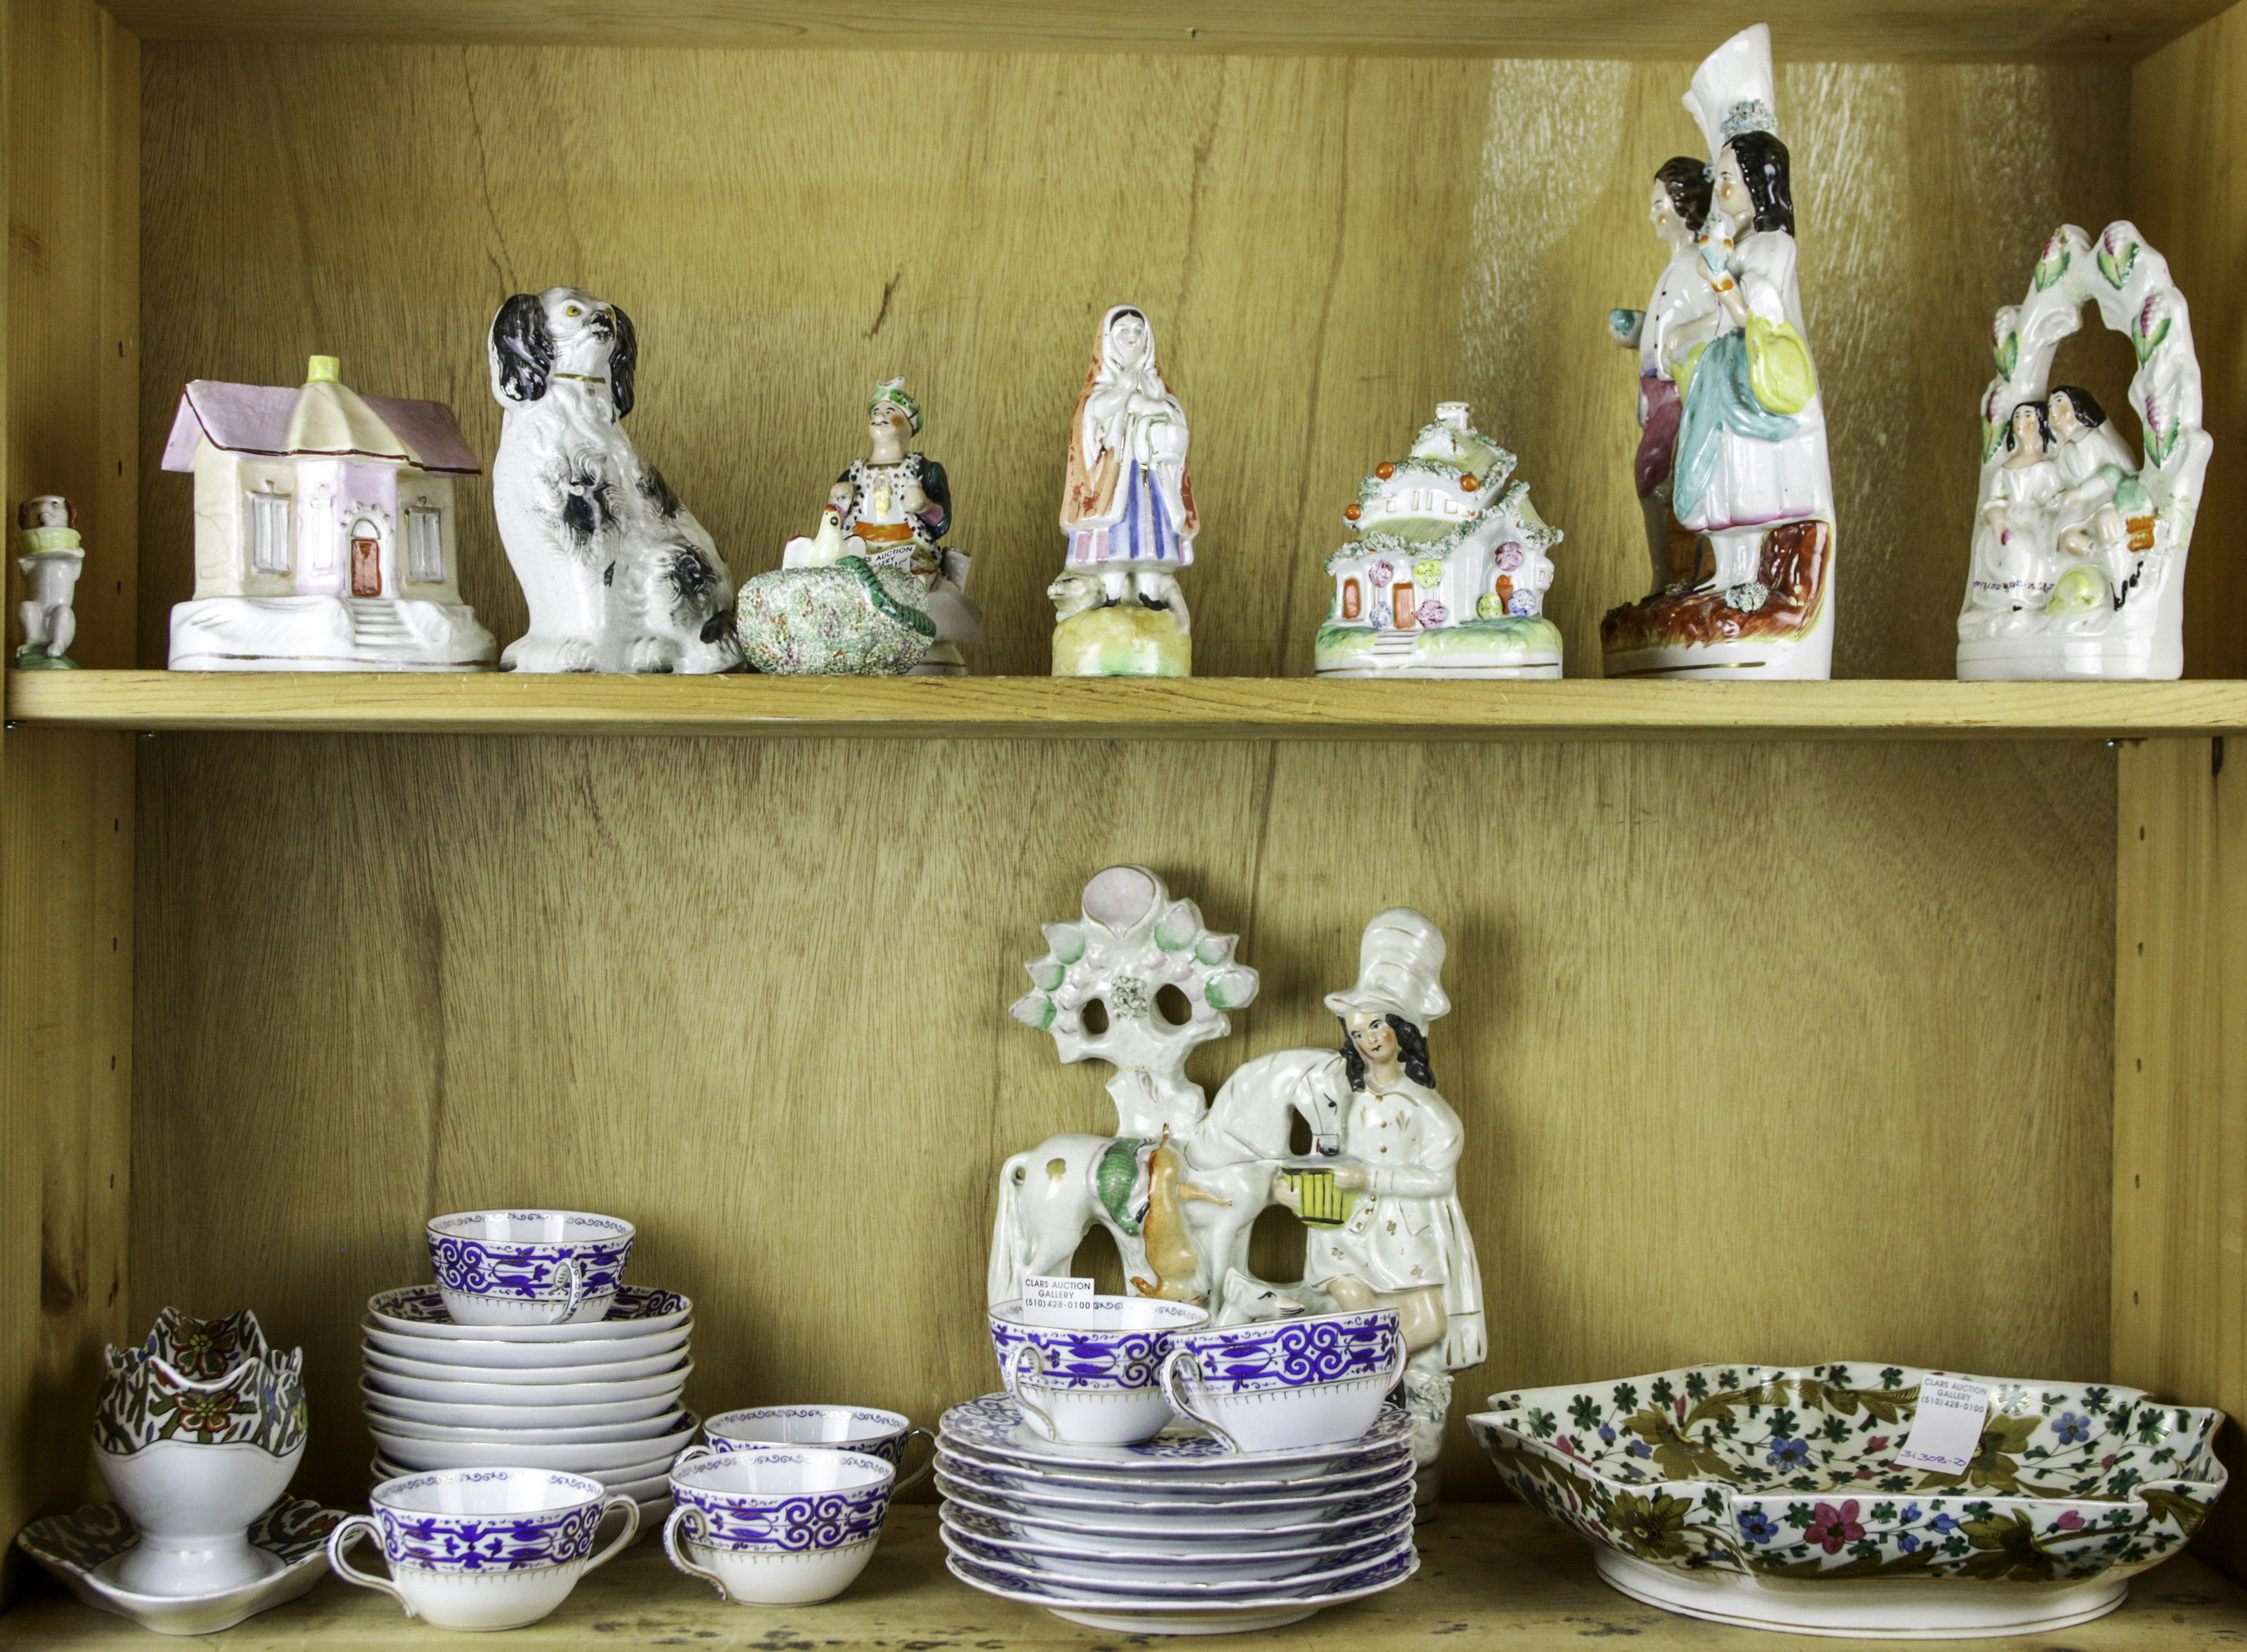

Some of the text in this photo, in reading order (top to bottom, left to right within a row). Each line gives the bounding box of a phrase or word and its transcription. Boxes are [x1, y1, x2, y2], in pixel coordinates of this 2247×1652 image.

[875, 547, 913, 562] AUCTION
[1025, 1279, 1090, 1290] CLARS AUCTION
[1039, 1290, 1074, 1299] GALLERY
[1925, 1378, 1987, 1395] CLARS AUCTION
[1937, 1389, 1971, 1401] GALLERY
